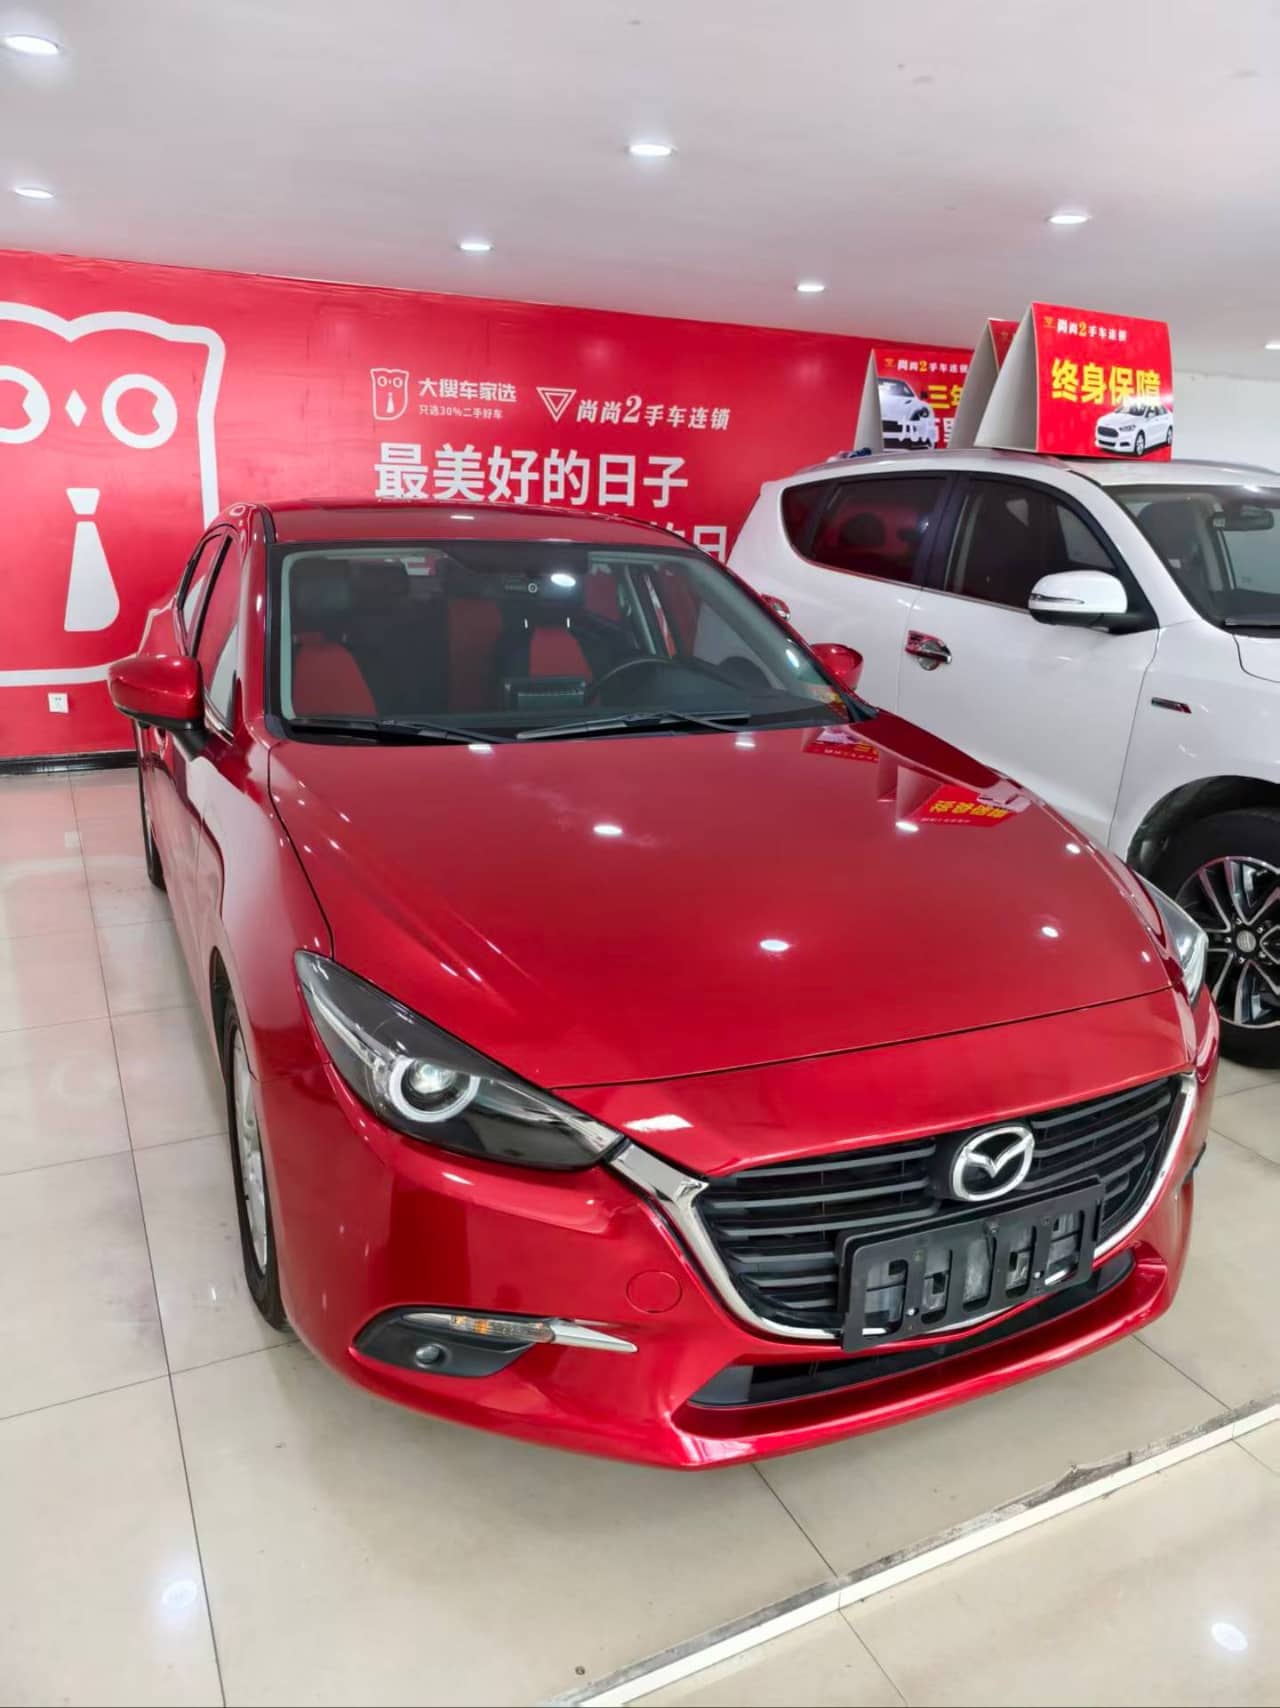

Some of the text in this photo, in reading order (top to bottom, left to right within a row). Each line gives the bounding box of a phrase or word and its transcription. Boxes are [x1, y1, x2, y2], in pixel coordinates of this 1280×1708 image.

[417, 377, 518, 403] 大搜车家选
[1051, 357, 1161, 406] 终身保障
[576, 395, 732, 431] 尚尚2手车连锁
[374, 441, 689, 509] 最美好的日子
